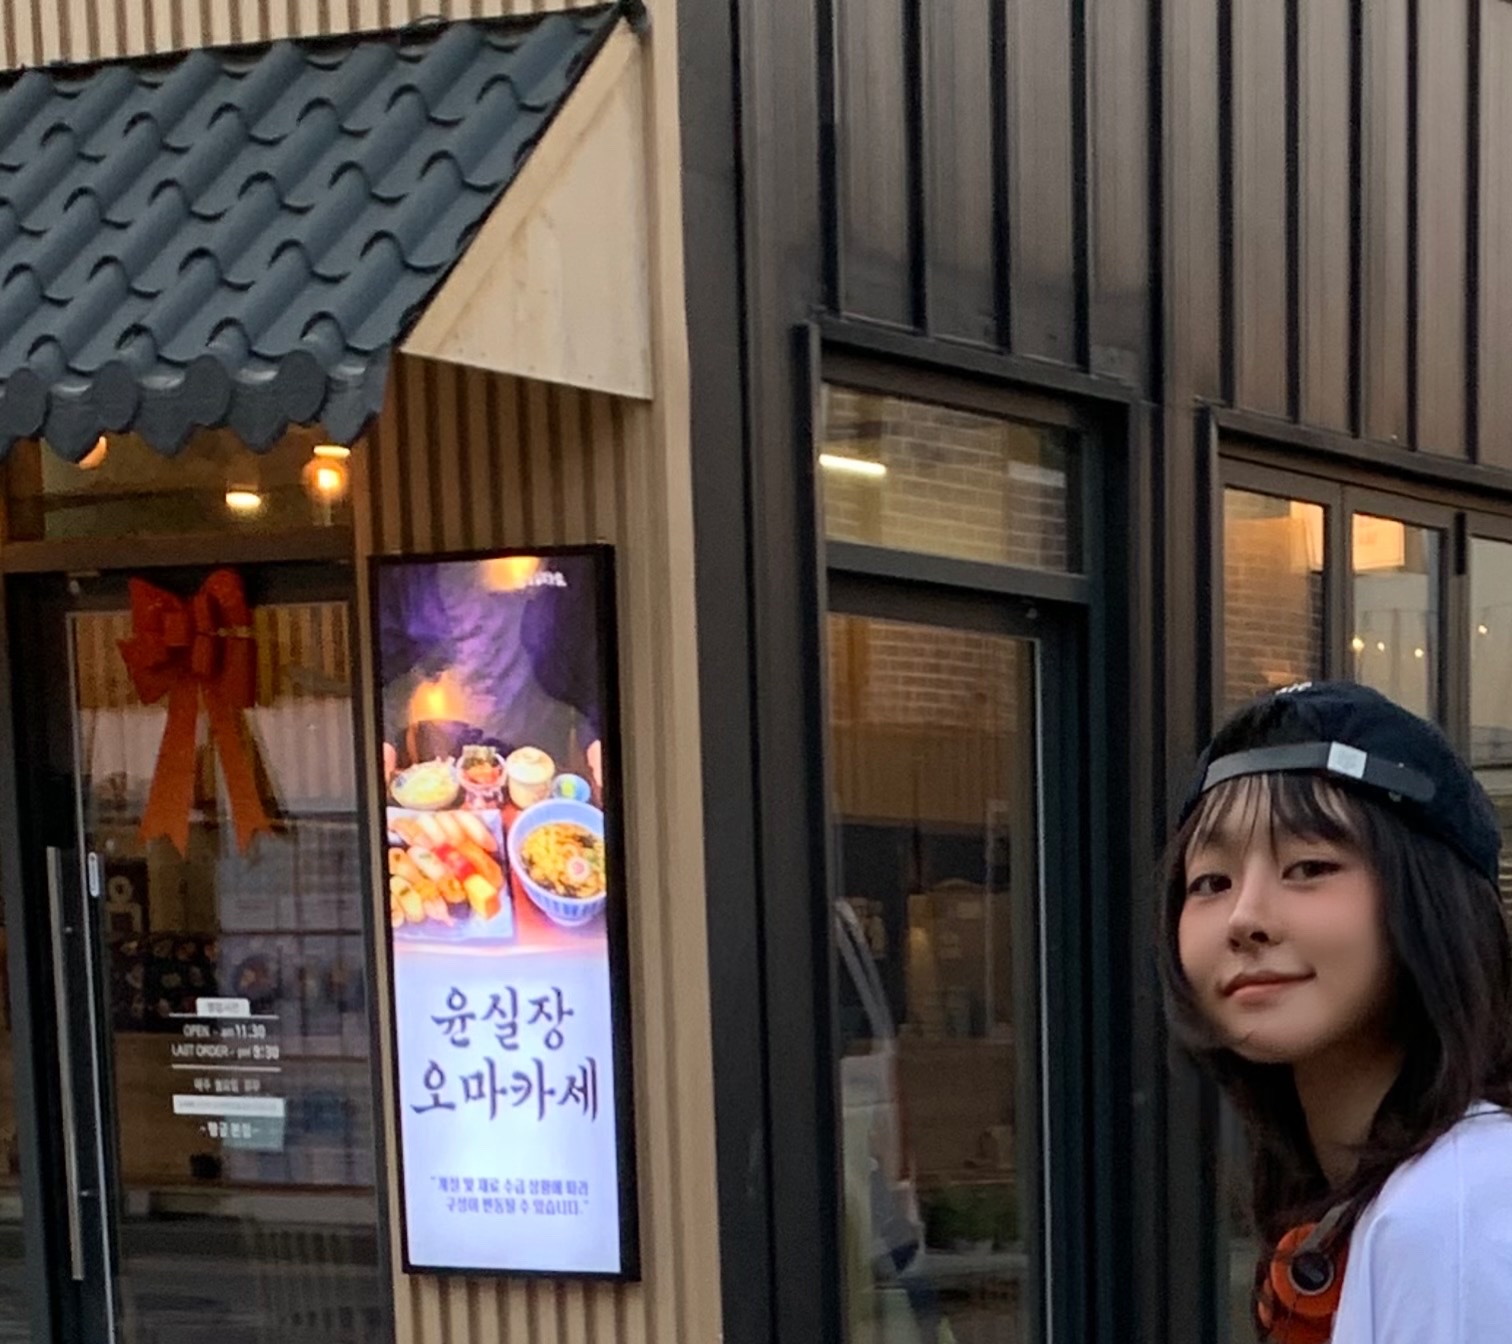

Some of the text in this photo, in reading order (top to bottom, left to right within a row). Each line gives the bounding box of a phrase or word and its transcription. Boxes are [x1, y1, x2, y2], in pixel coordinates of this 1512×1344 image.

[183, 1024, 211, 1038] OPEN
[430, 985, 575, 1051] 윤실장
[171, 1043, 195, 1057] LAST
[196, 1044, 229, 1058] ORDER
[410, 1055, 598, 1123] 오마카세
